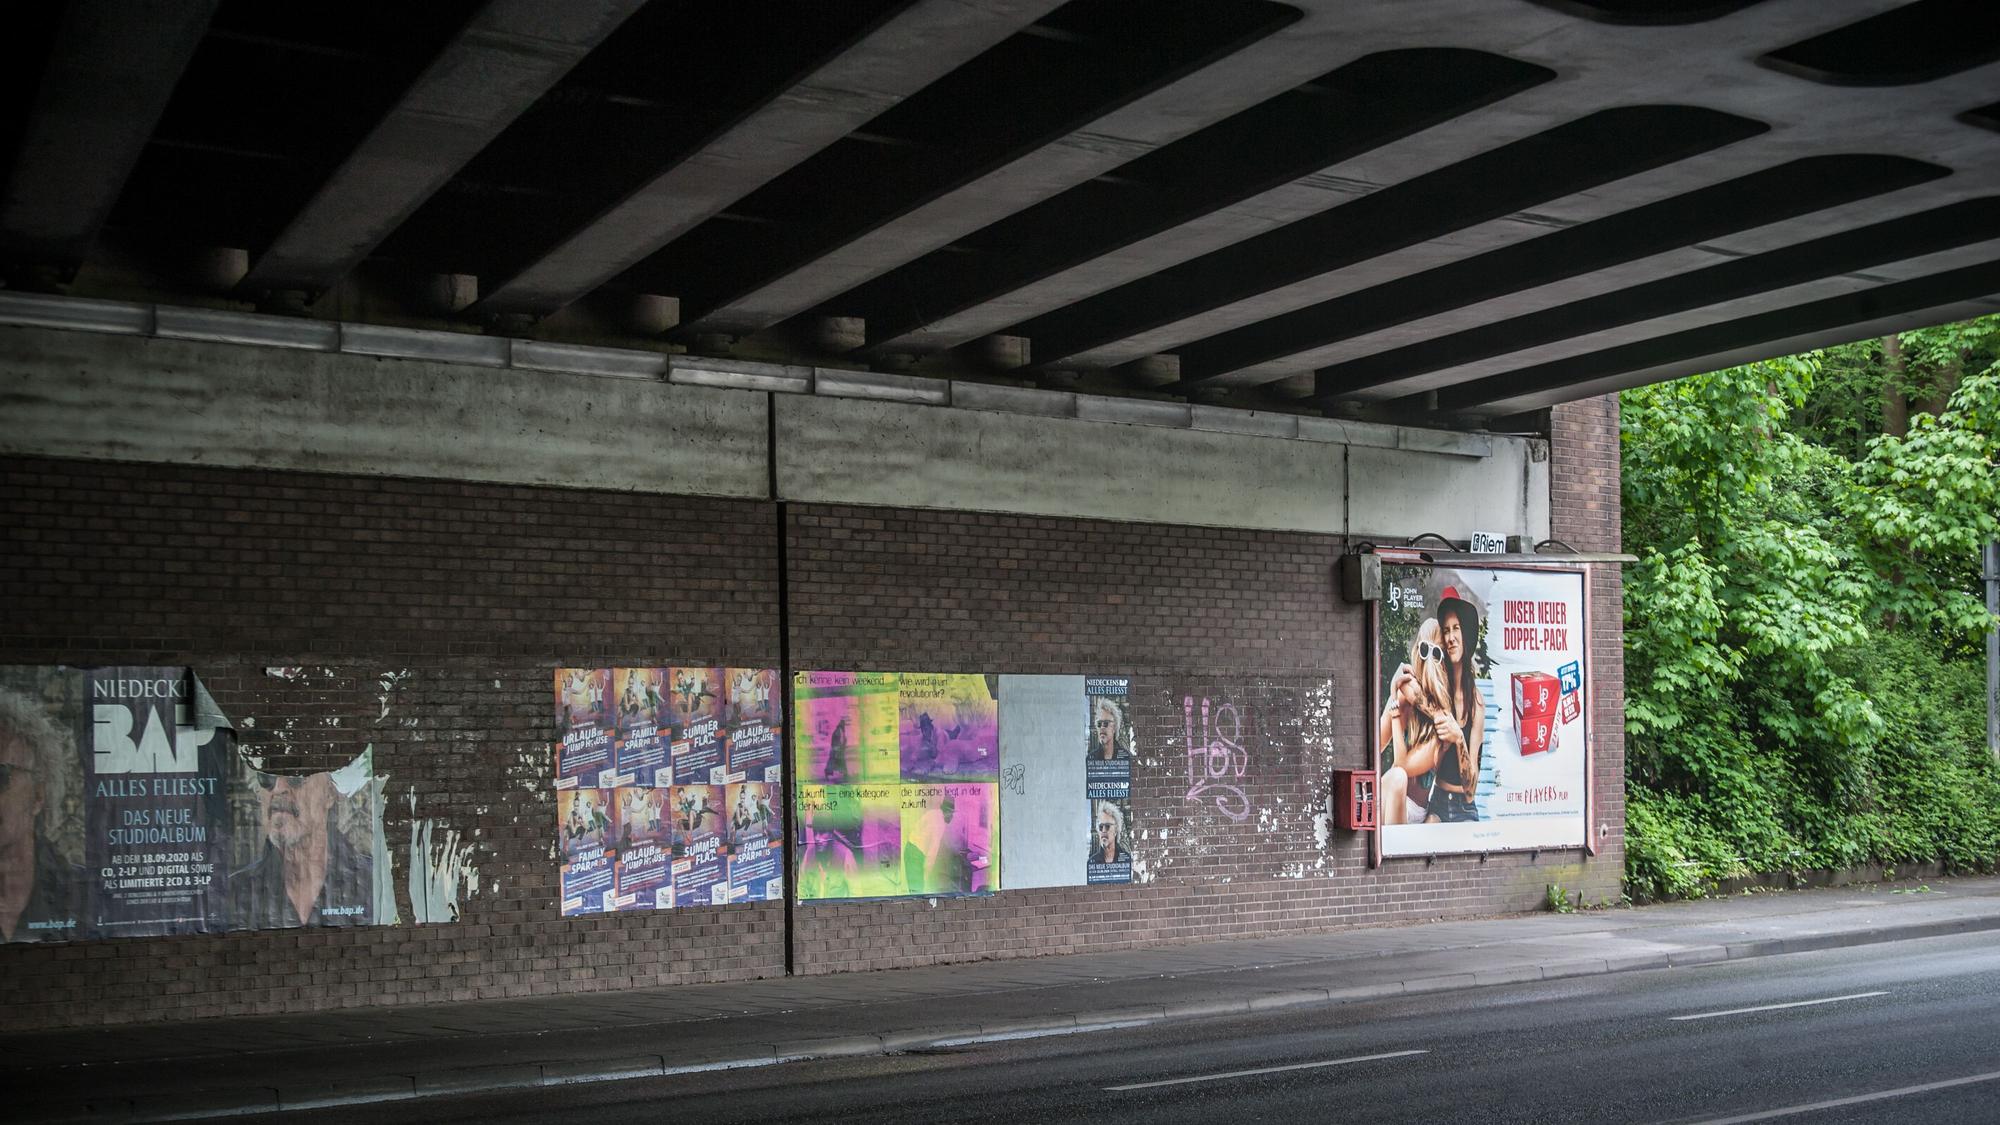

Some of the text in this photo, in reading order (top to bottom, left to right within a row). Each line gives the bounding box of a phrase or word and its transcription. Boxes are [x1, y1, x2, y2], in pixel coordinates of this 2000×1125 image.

[1480, 534, 1504, 553] Riem
[1504, 600, 1566, 624] UNSER NEUER
[1504, 628, 1567, 651] DOPPEL-PACK
[853, 675, 885, 686] weekend
[1088, 686, 1128, 695] ALLES FLIESST
[562, 727, 597, 746] URLAUB
[631, 726, 658, 740] FAMILY
[682, 720, 718, 739] SUMMER
[732, 725, 763, 742] URLAUB
[93, 704, 216, 774] BAP
[735, 739, 752, 751] JUMP
[567, 741, 585, 755] JUMP
[96, 778, 217, 797] ALLES FLIESST
[901, 788, 912, 797] die
[915, 787, 942, 797] ursache
[969, 786, 981, 796] der
[1088, 782, 1120, 790] NIEDECKENS
[798, 788, 825, 799] zukunft
[839, 788, 854, 798] eine
[856, 788, 890, 800] kategorie
[1088, 790, 1129, 798] ALLES FLIESST
[1524, 785, 1557, 804] PLAYERS
[901, 799, 927, 809] zukunft
[123, 809, 191, 825] DAS NEUE
[109, 827, 206, 845] STUDIOALBUM
[684, 837, 720, 857] SUMMER
[743, 838, 769, 852] FAMILY
[124, 854, 140, 864] DEM
[142, 853, 189, 863] 18.09.2020
[191, 852, 204, 861] ALS
[578, 847, 605, 861] FAMILY
[621, 845, 655, 864] URLAUB
[101, 864, 214, 878] CD, 2-LP UND DIGITAL SOWIE
[625, 859, 643, 872] JUMP
[104, 876, 212, 889] ALS LIMITIERTE 2CD & 3-LP
[322, 904, 365, 916] www.bap.de
